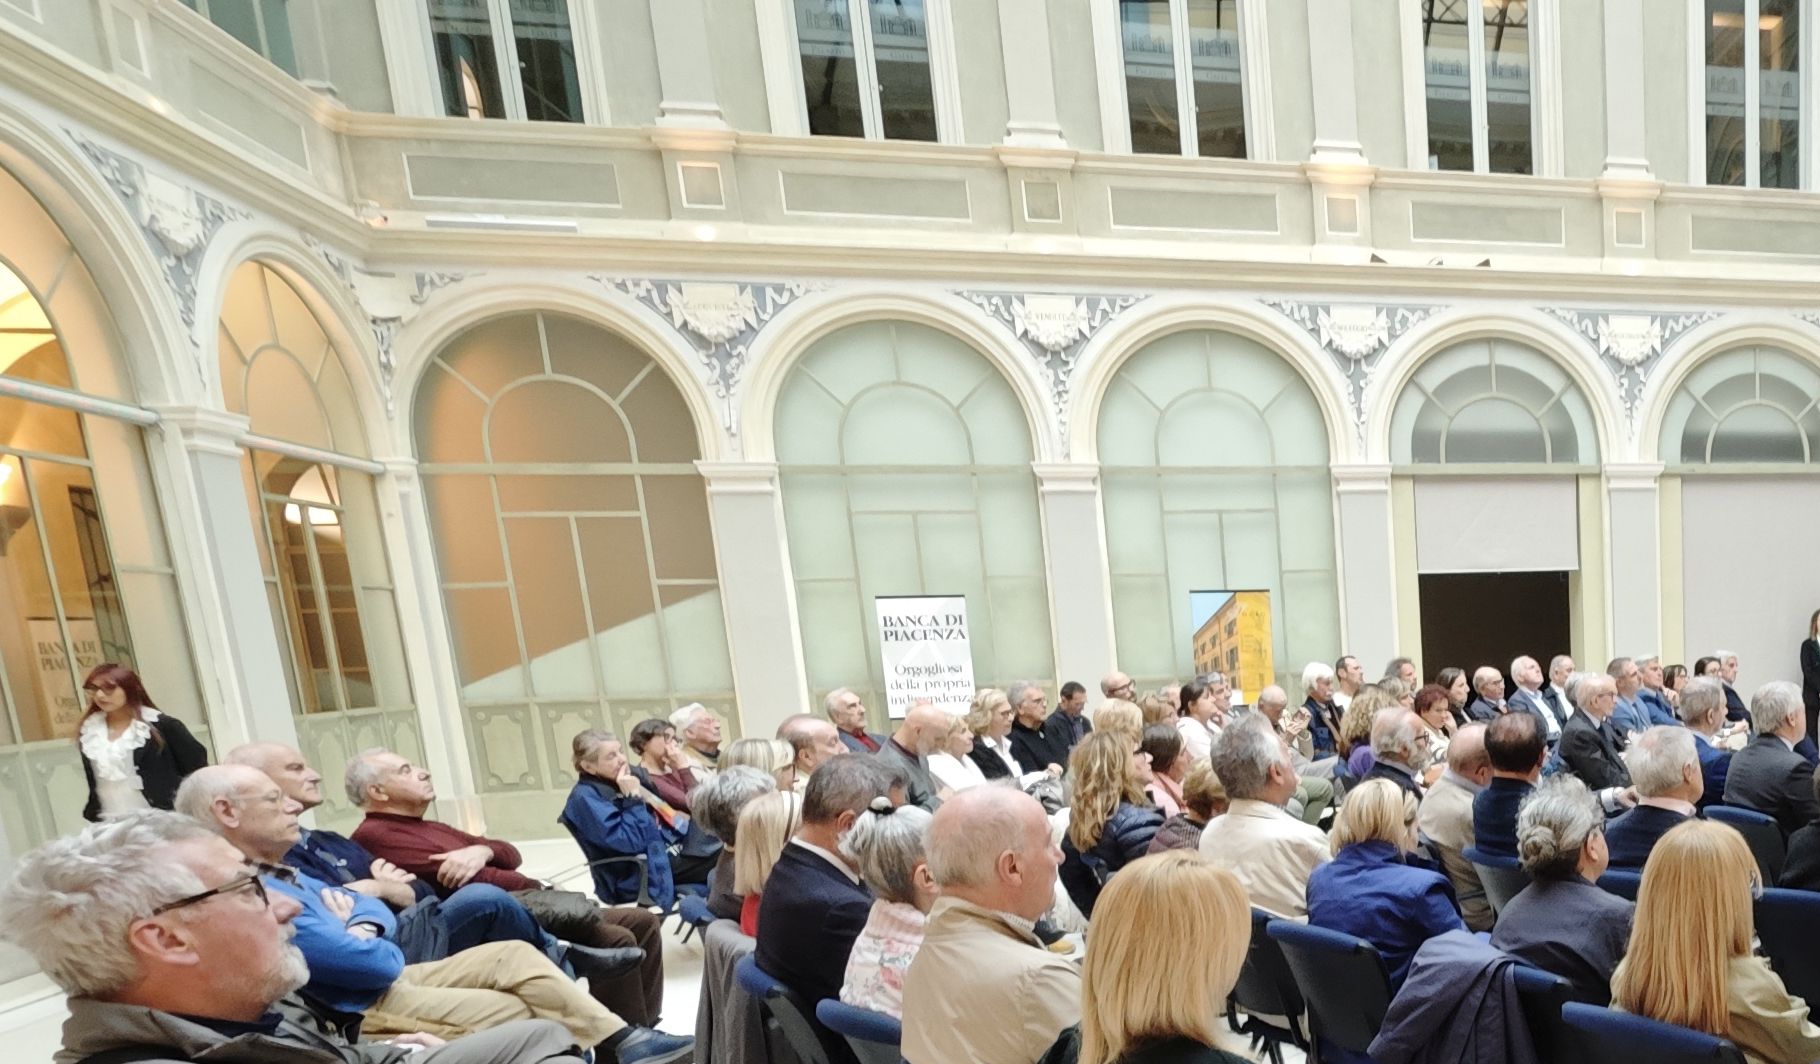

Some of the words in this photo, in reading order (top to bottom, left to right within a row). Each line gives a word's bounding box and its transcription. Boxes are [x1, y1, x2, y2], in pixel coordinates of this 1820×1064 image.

[883, 615, 940, 627] BANCA
[945, 614, 963, 626] DI
[884, 628, 966, 641] PIACENZA
[895, 662, 962, 677] Orgogliosa
[891, 679, 919, 690] della
[925, 680, 970, 692] propria
